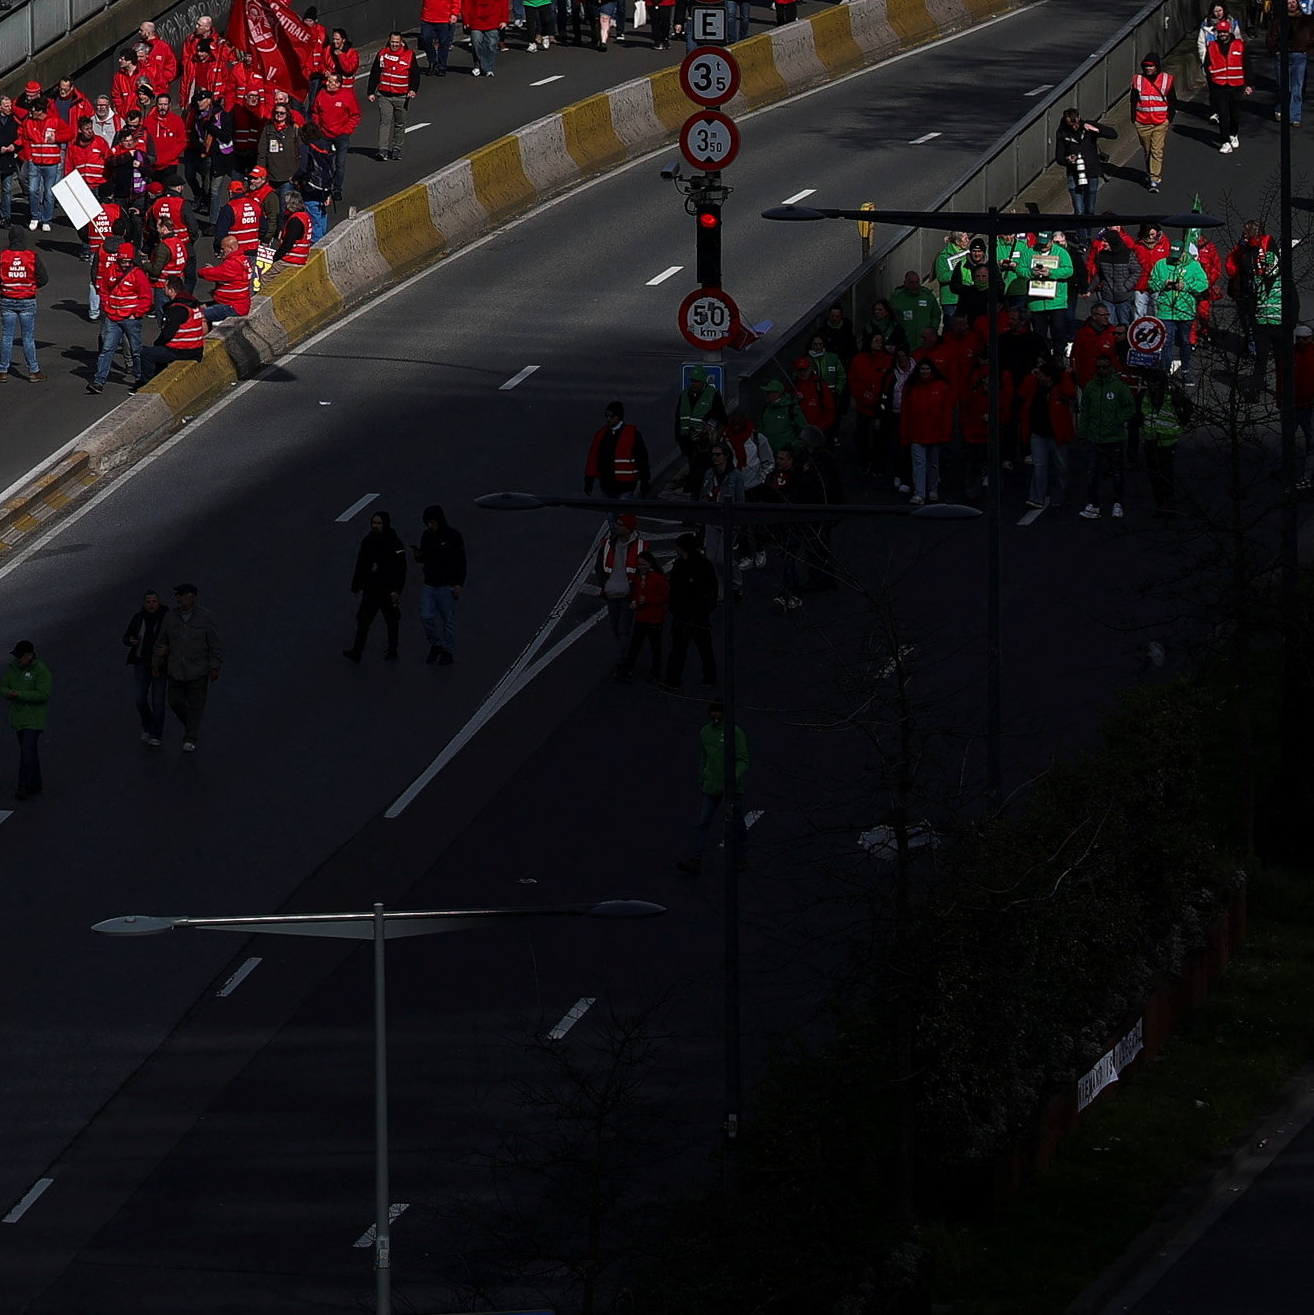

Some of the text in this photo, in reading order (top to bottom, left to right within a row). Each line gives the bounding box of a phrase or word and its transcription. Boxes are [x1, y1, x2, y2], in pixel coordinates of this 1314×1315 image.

[269, 1, 311, 44] CENTRALE
[702, 13, 716, 36] E
[693, 303, 725, 327] 50
[701, 327, 716, 337] km
